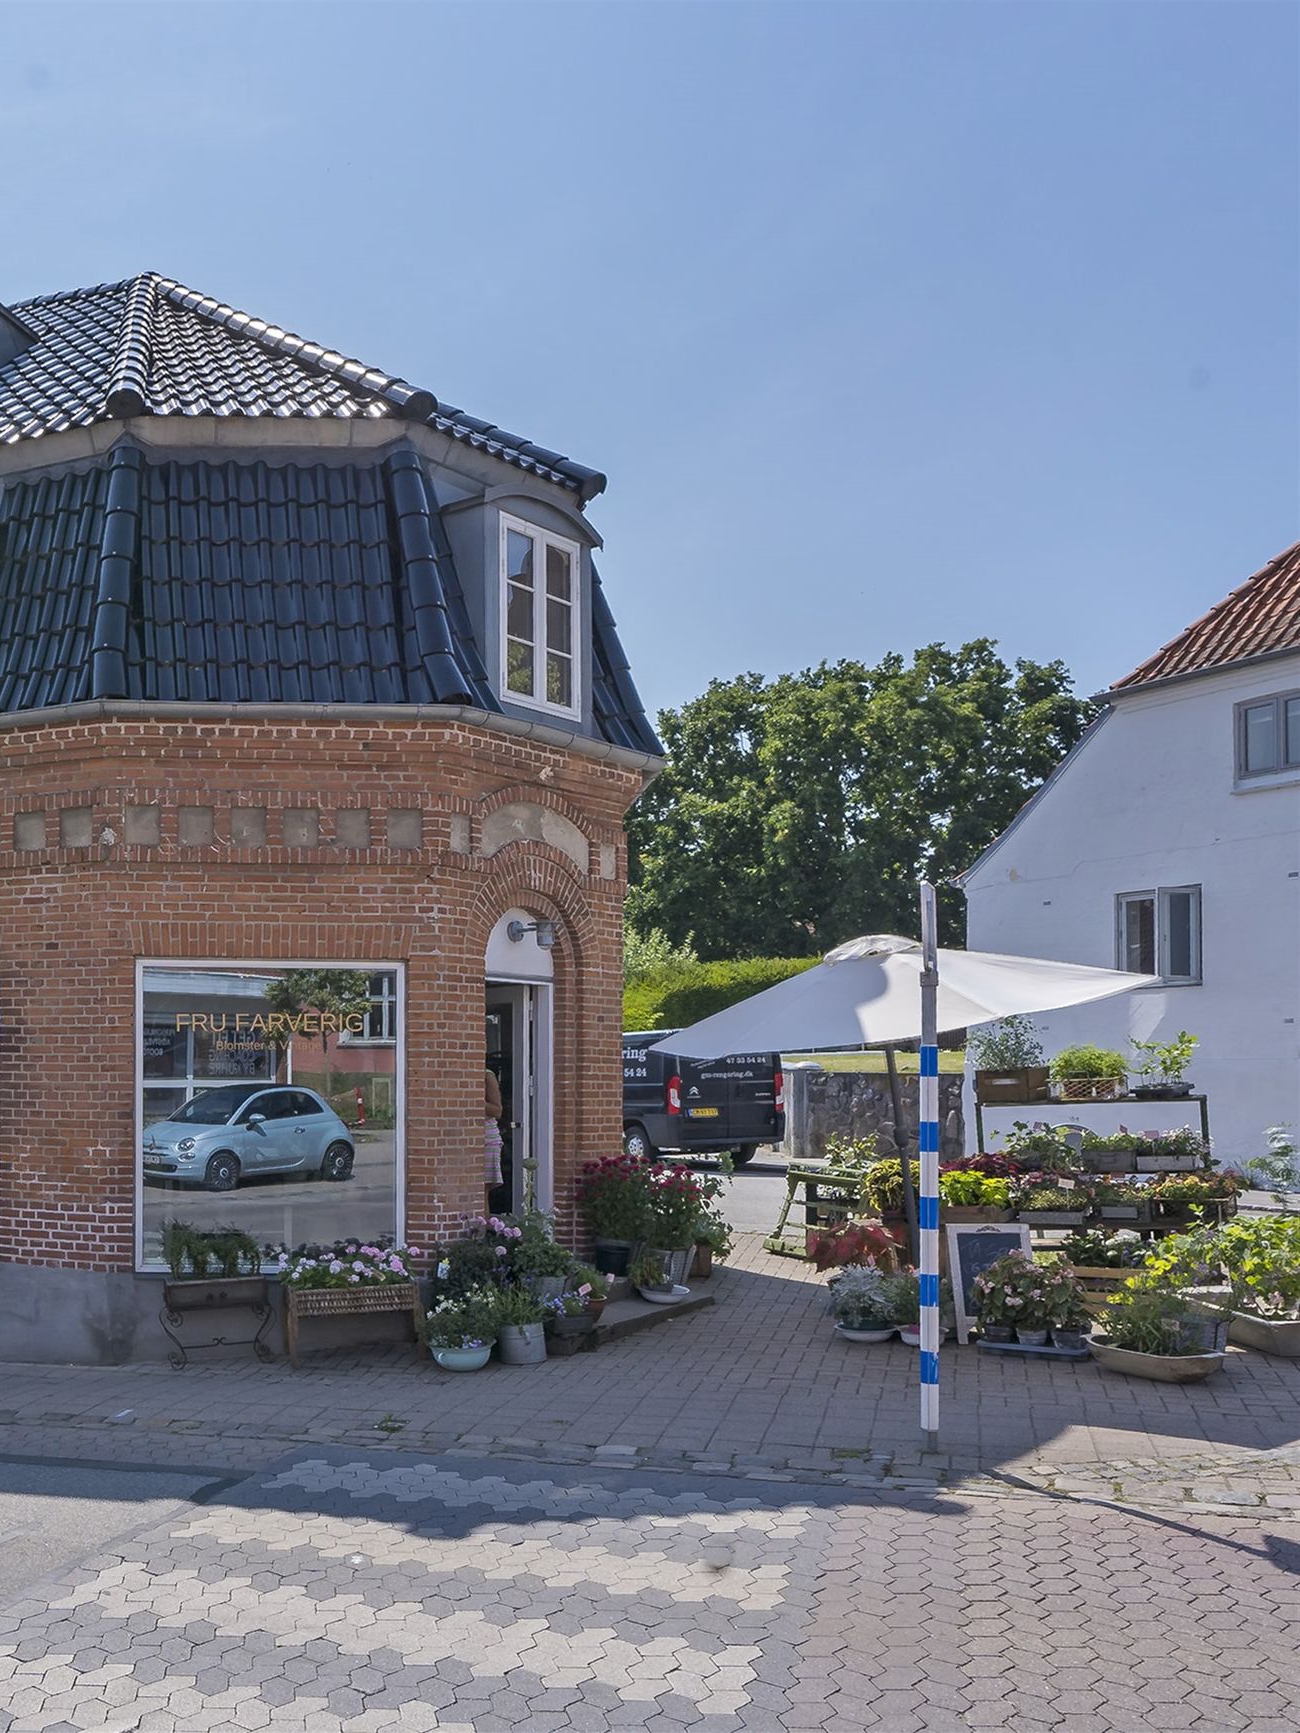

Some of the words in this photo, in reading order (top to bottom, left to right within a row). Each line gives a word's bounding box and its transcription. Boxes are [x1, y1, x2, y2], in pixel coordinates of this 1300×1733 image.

[176, 1013, 226, 1032] FRU
[236, 1013, 364, 1032] FARVERIG
[216, 1041, 265, 1051] Blomster
[268, 1040, 277, 1051] &
[624, 1068, 634, 1078] 54
[636, 1068, 647, 1077] 24
